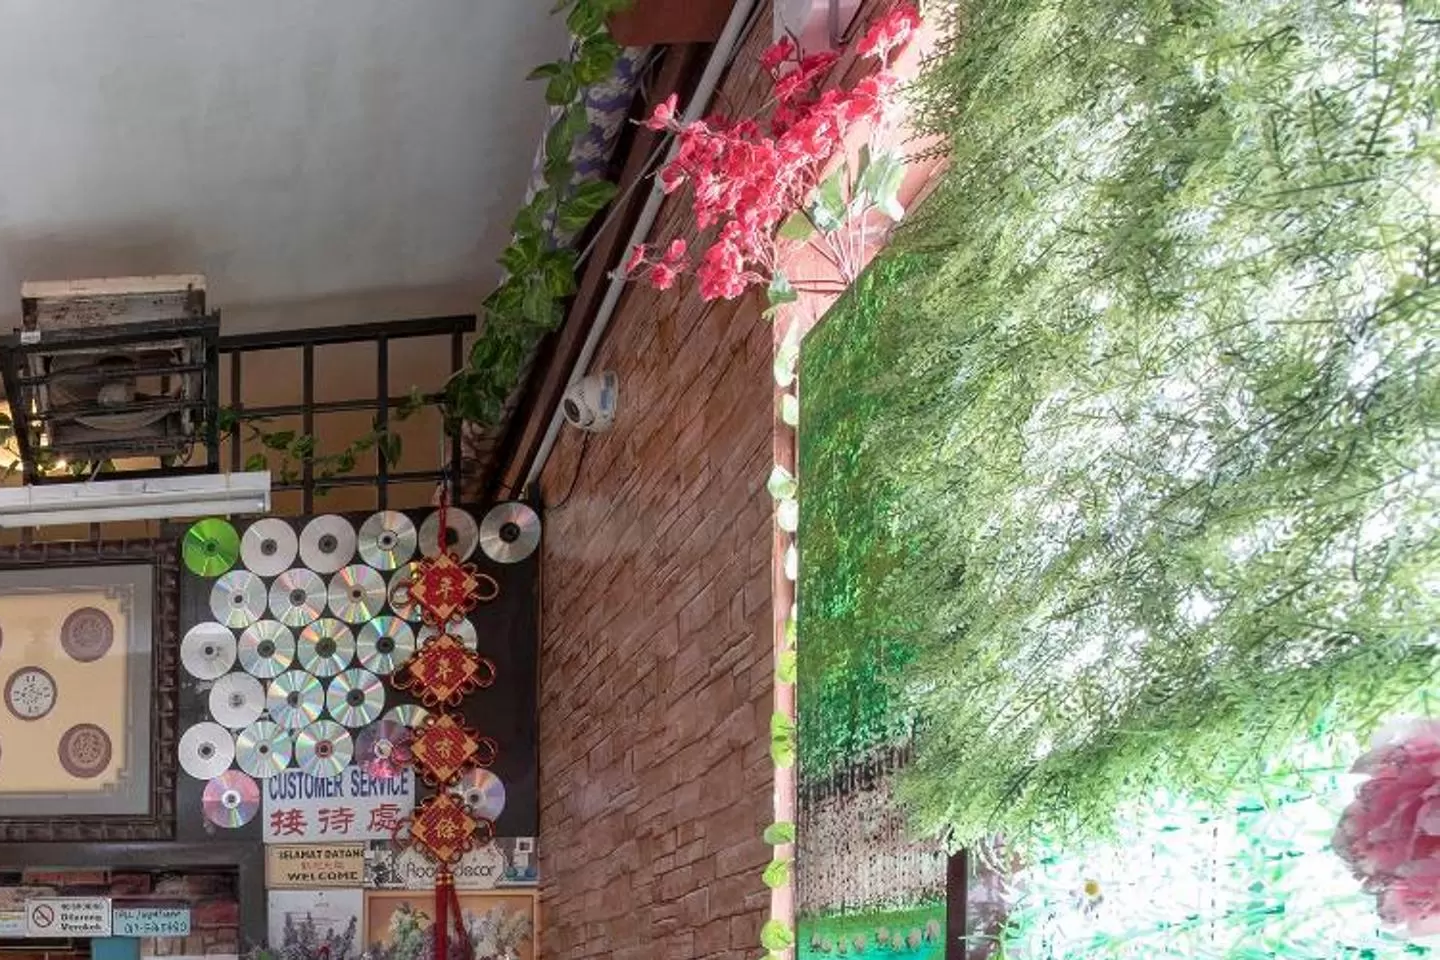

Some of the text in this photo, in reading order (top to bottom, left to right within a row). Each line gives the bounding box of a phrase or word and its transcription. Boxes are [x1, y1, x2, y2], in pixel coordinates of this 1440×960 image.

[268, 767, 409, 800] CUSTOMER SERVICE
[287, 871, 358, 881] WELCOME
